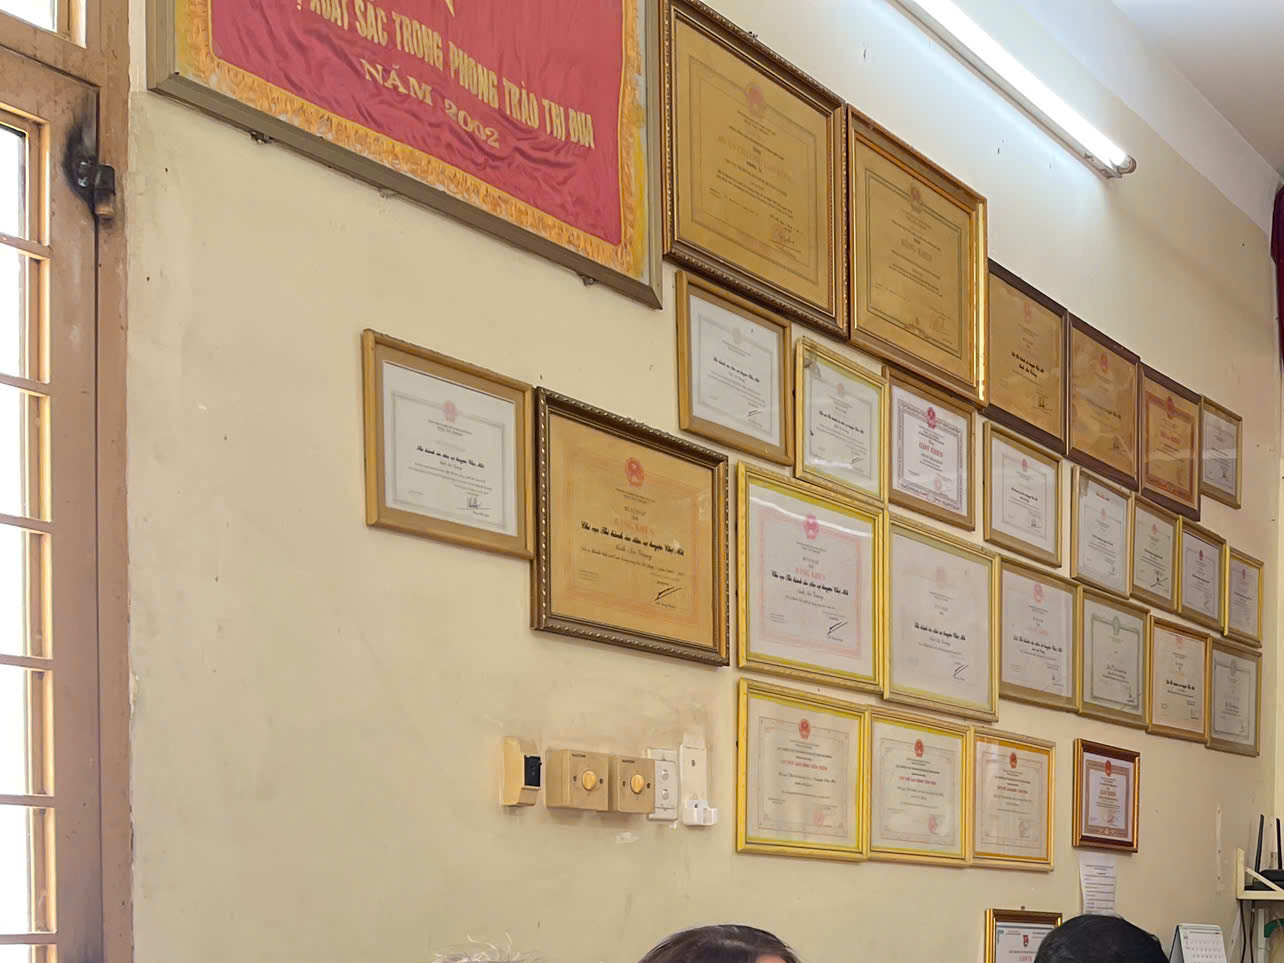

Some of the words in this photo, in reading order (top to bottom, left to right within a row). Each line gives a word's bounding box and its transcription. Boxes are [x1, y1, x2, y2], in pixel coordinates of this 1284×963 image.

[360, 58, 433, 106] NĂM
[445, 98, 500, 149] 2002
[392, 10, 443, 72] TRONG
[448, 40, 499, 109] PHONG
[503, 77, 539, 129] TRÀO
[542, 98, 566, 142] THI
